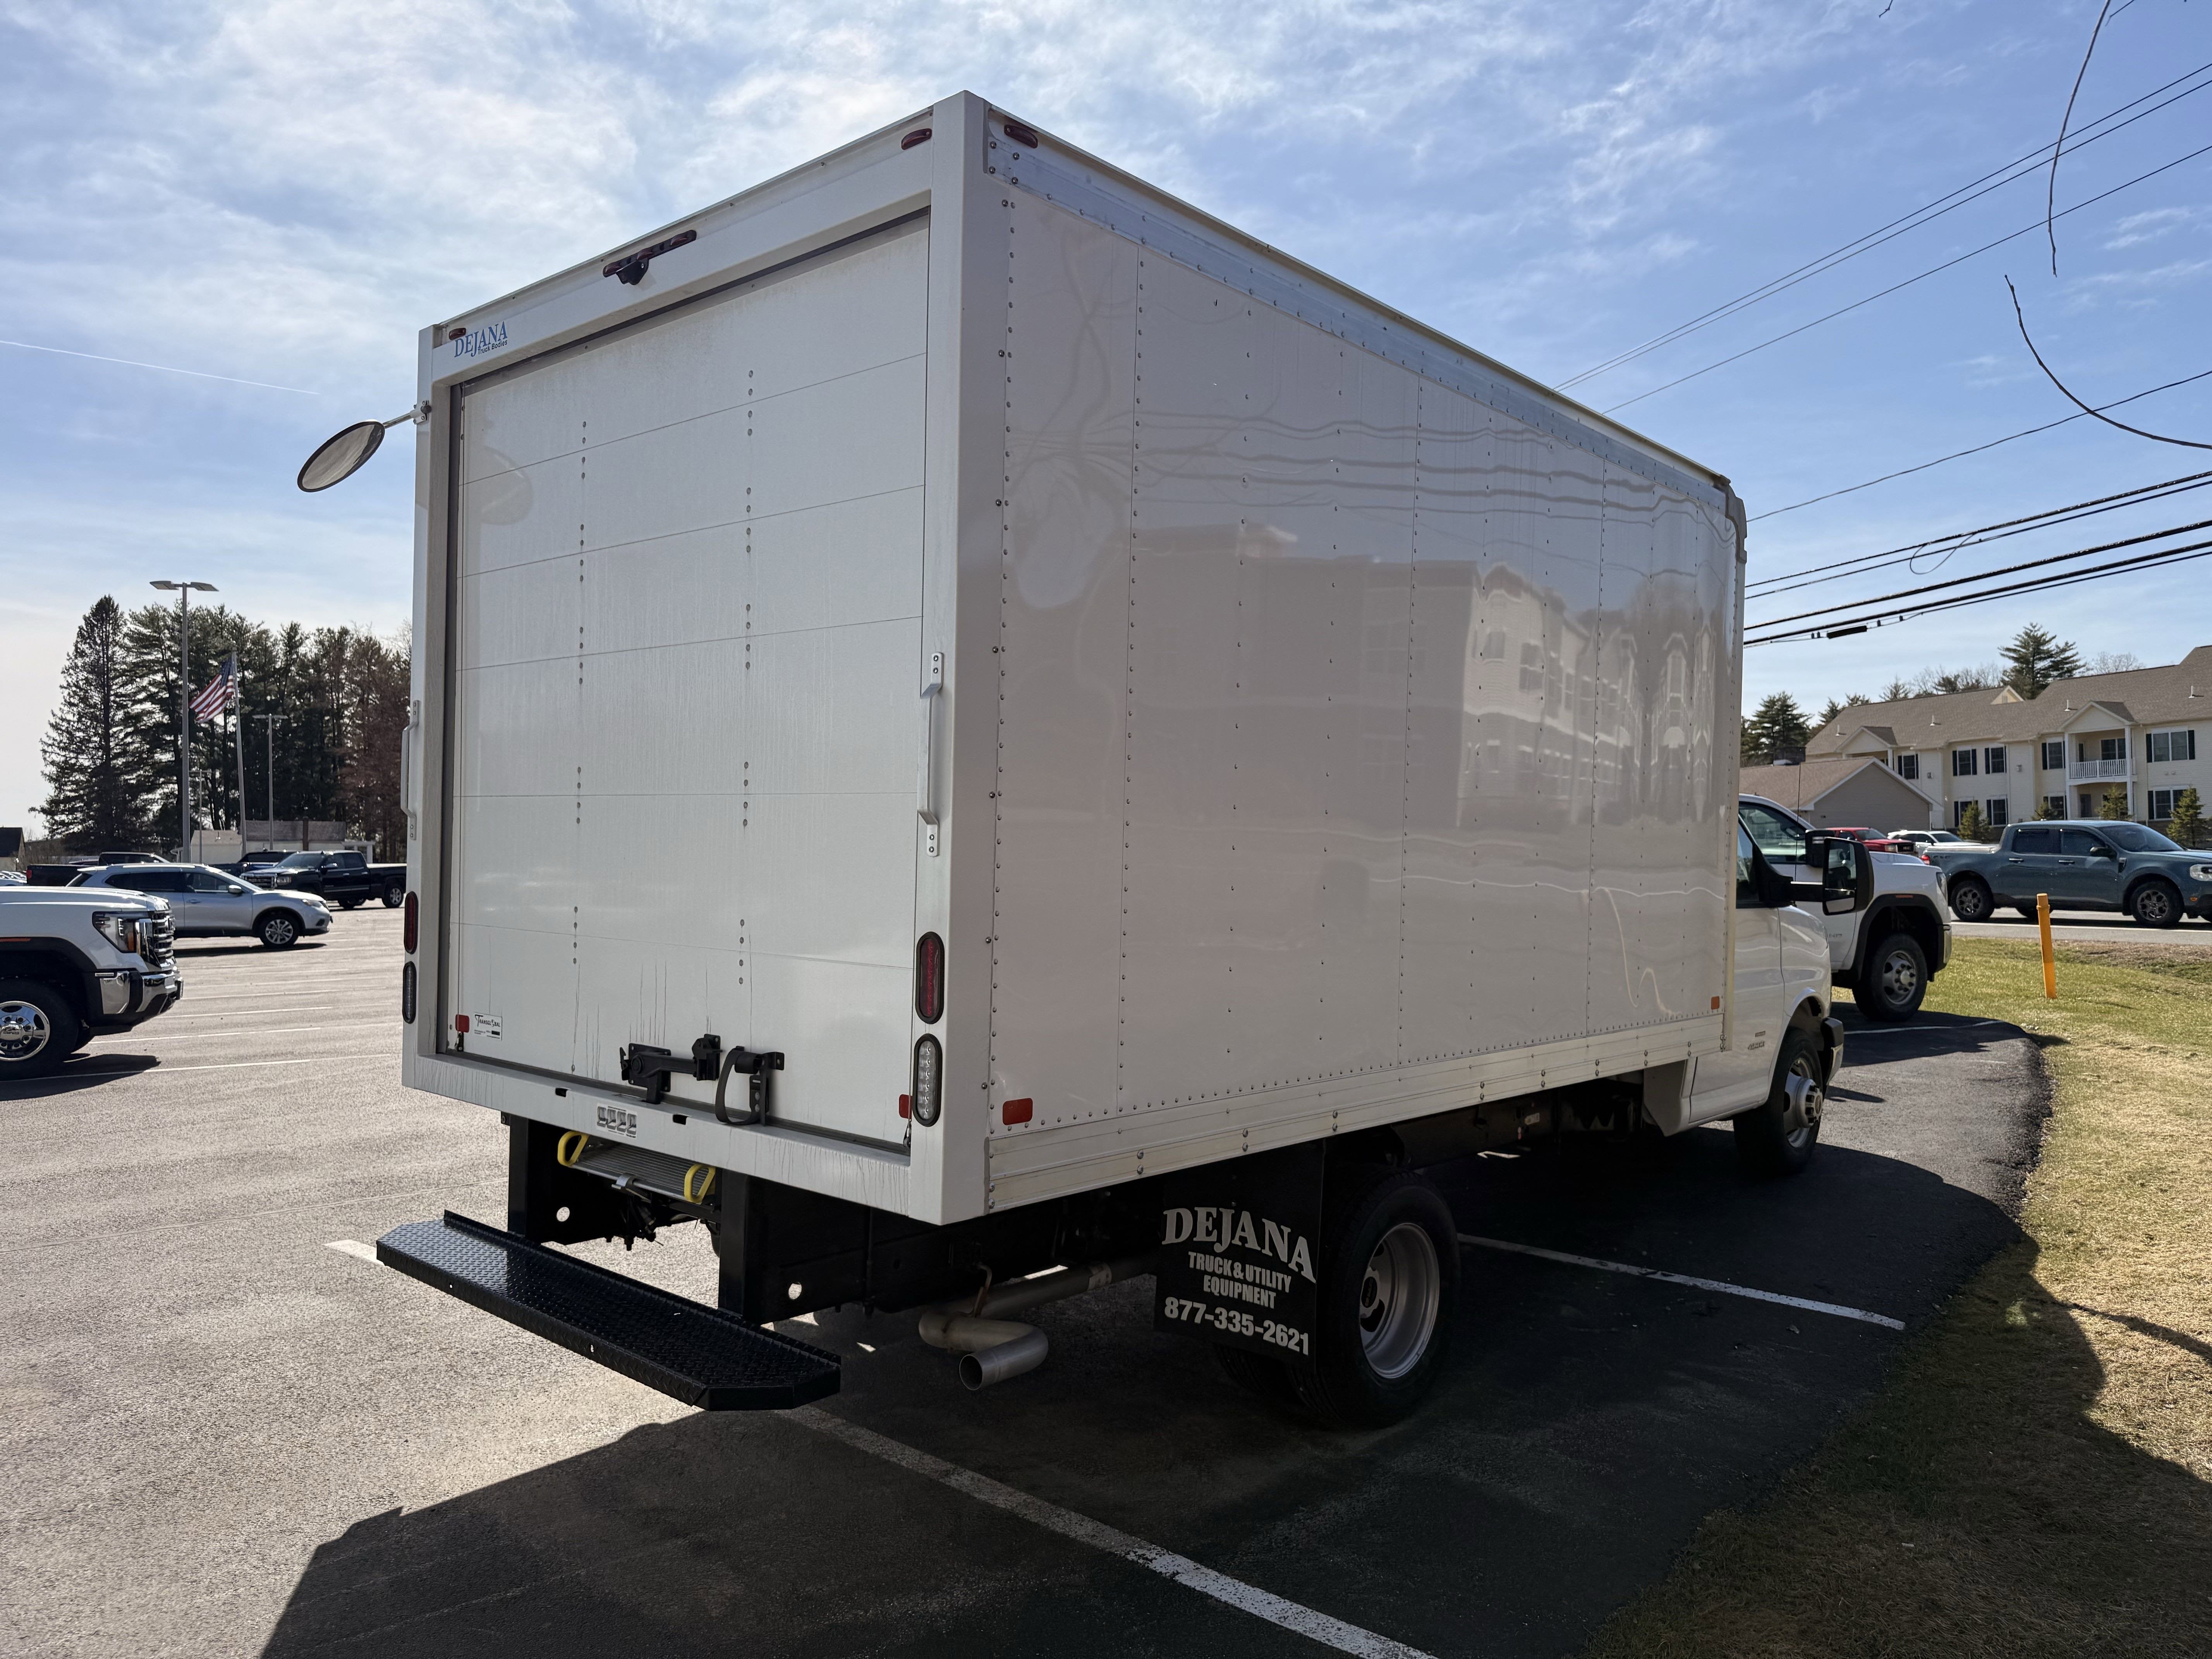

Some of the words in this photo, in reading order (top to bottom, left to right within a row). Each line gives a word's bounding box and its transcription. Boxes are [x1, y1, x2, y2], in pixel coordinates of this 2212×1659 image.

[454, 321, 507, 357] DEJANA
[477, 345, 490, 354] Truck
[491, 340, 507, 350] Bodies
[1162, 1207, 1316, 1283] DEJANA
[1203, 1274, 1276, 1309] EQUIPMENT
[1164, 1297, 1309, 1355] 877-335-2621
